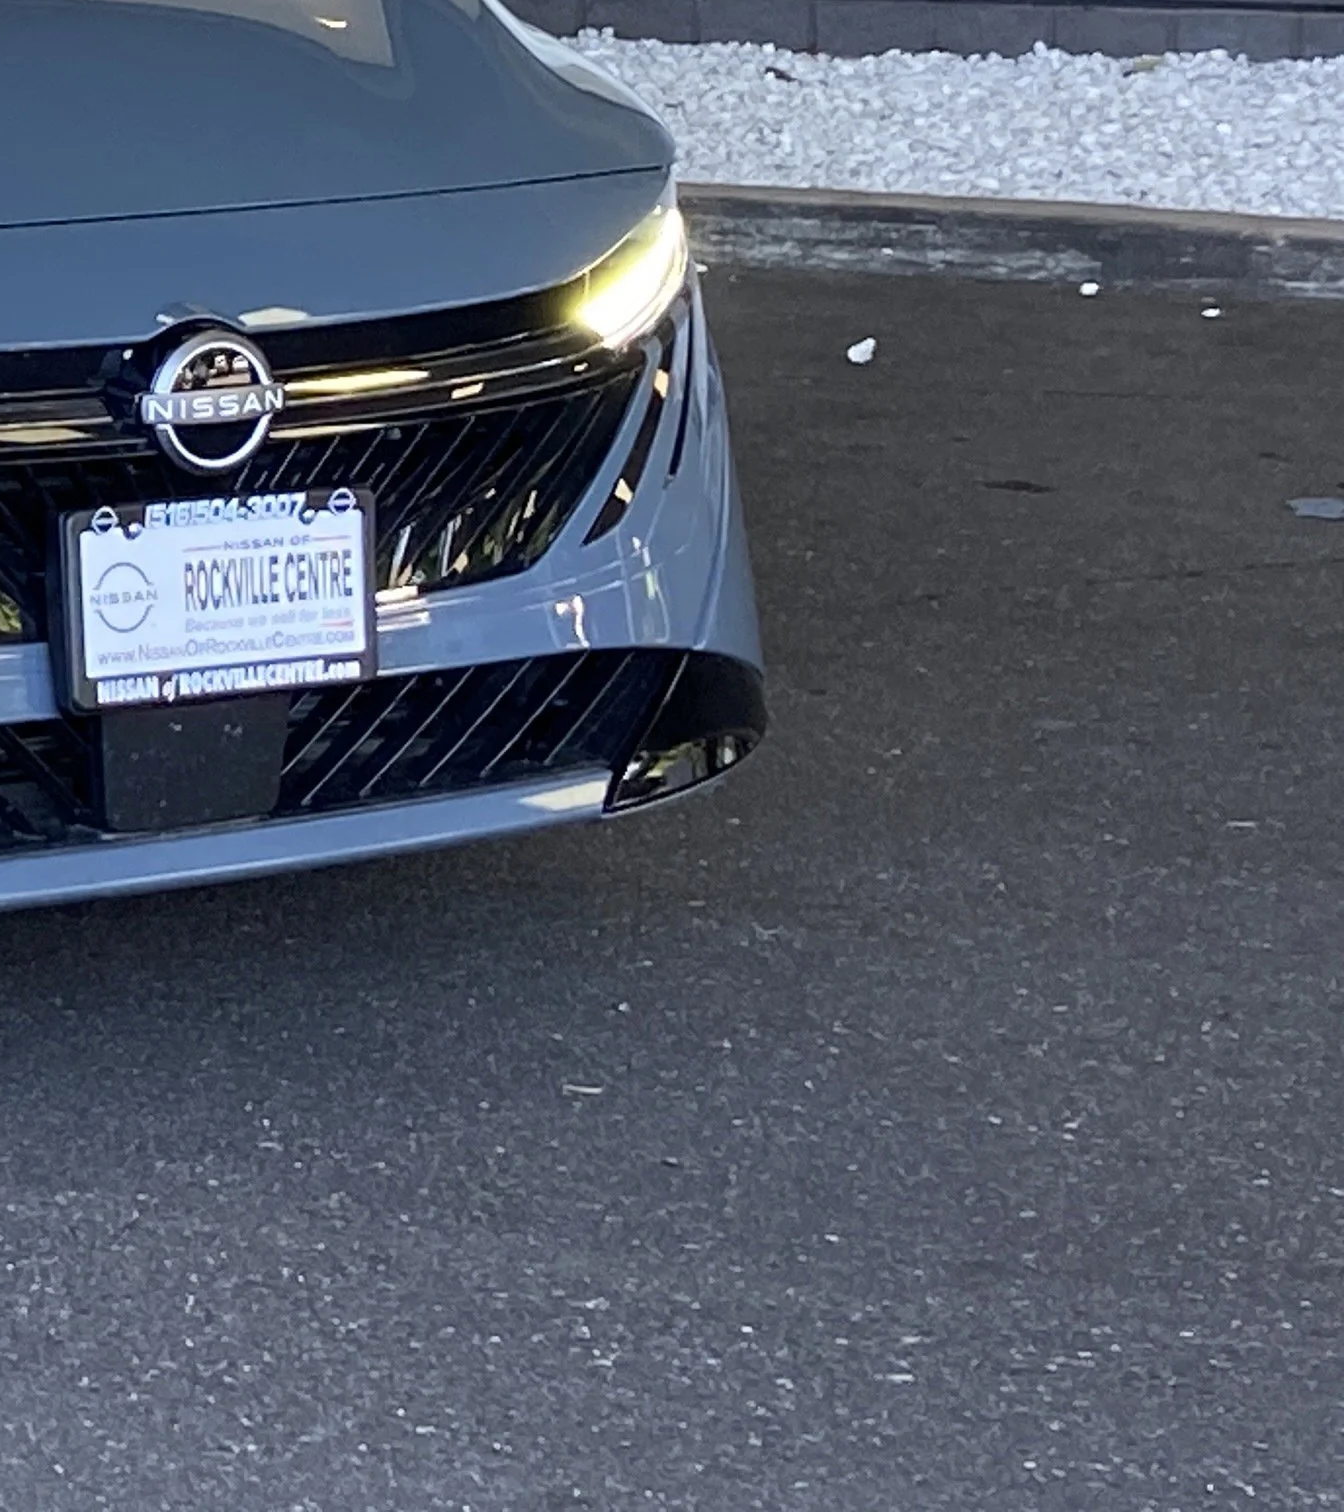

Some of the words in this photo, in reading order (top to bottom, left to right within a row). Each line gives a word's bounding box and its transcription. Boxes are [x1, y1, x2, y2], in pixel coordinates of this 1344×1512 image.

[148, 386, 284, 421] NISSAN
[223, 537, 284, 551] NISSAN
[289, 534, 311, 547] OF
[89, 588, 158, 606] NISSAN
[184, 554, 280, 613] ROCKVILLE
[284, 548, 353, 603] CENTRE
[96, 675, 159, 705] NISSAN
[161, 672, 181, 704] of
